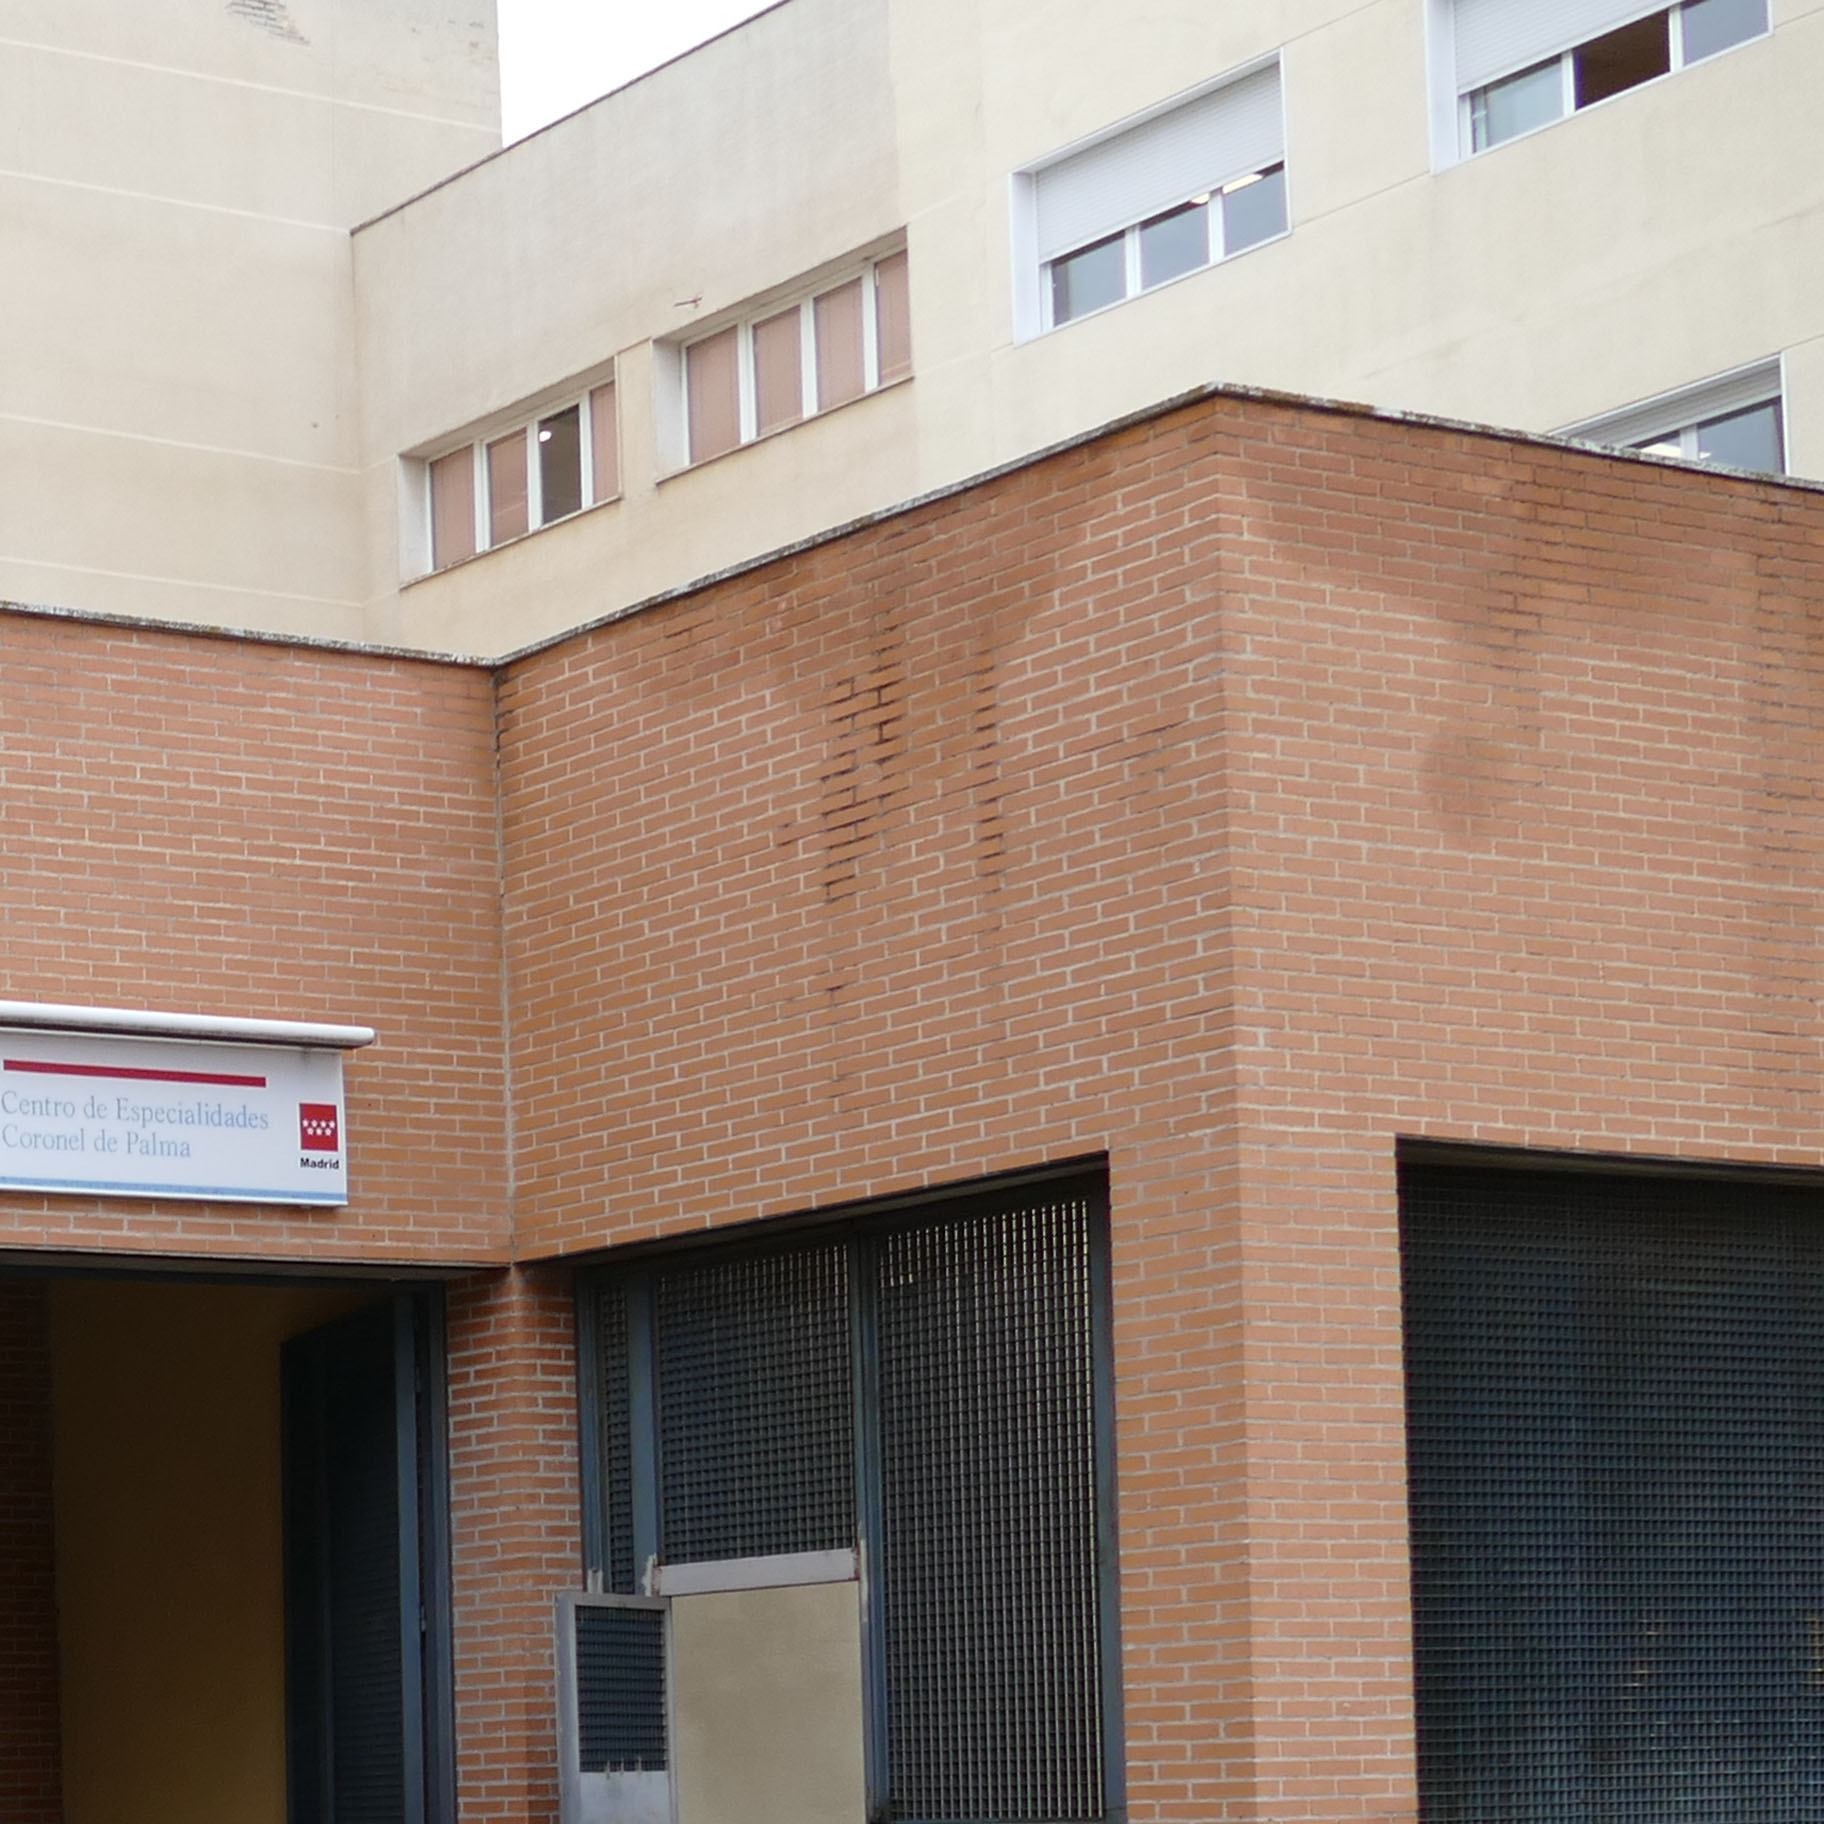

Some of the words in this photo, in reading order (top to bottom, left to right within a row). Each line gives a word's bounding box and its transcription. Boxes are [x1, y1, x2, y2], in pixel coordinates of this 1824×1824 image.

[0, 1091, 76, 1118] Centro
[83, 1096, 108, 1120] de
[116, 1097, 270, 1130] Especialidades
[1, 1124, 85, 1151] Coronel
[93, 1129, 118, 1153] de
[127, 1131, 191, 1158] Palma
[300, 1157, 340, 1170] Madrid
